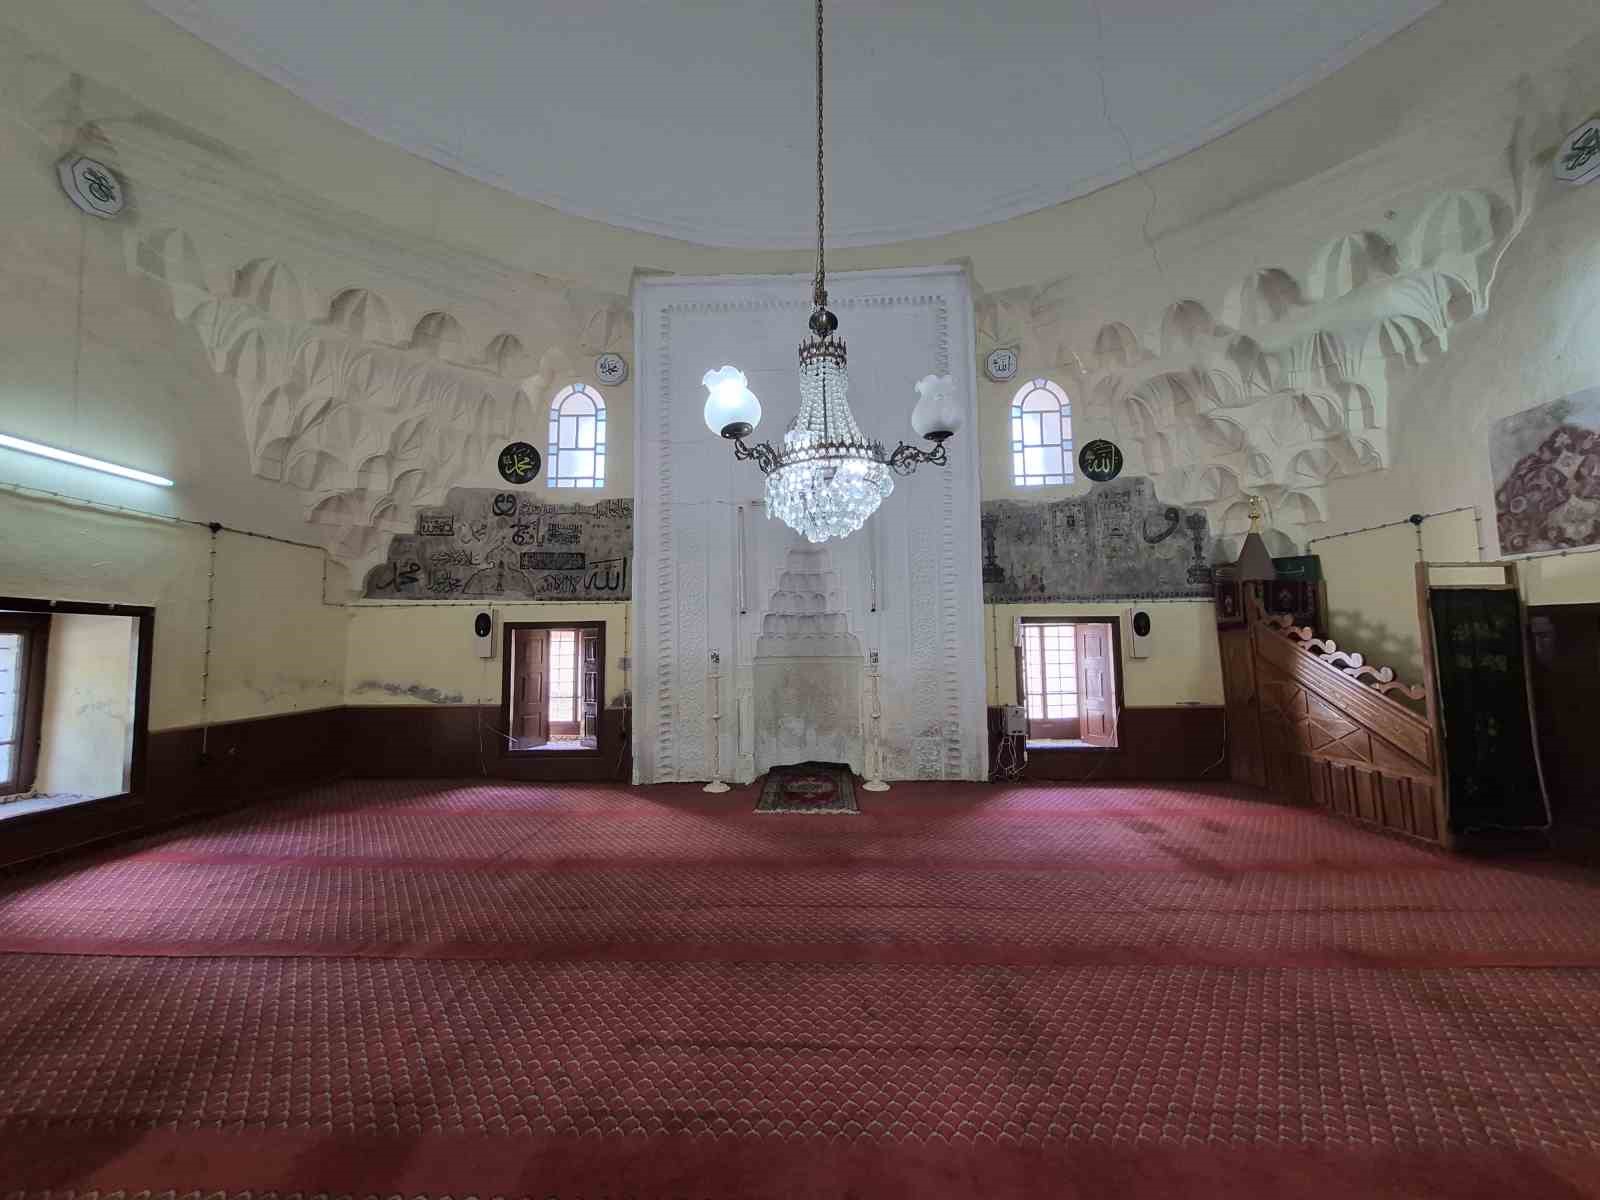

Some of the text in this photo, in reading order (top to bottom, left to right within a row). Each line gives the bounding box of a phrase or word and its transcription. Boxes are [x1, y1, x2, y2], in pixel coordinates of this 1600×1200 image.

[505, 454, 533, 476] محمد
[1088, 443, 1115, 472] الله
[376, 561, 421, 593] محمد
[584, 556, 628, 593] الله
